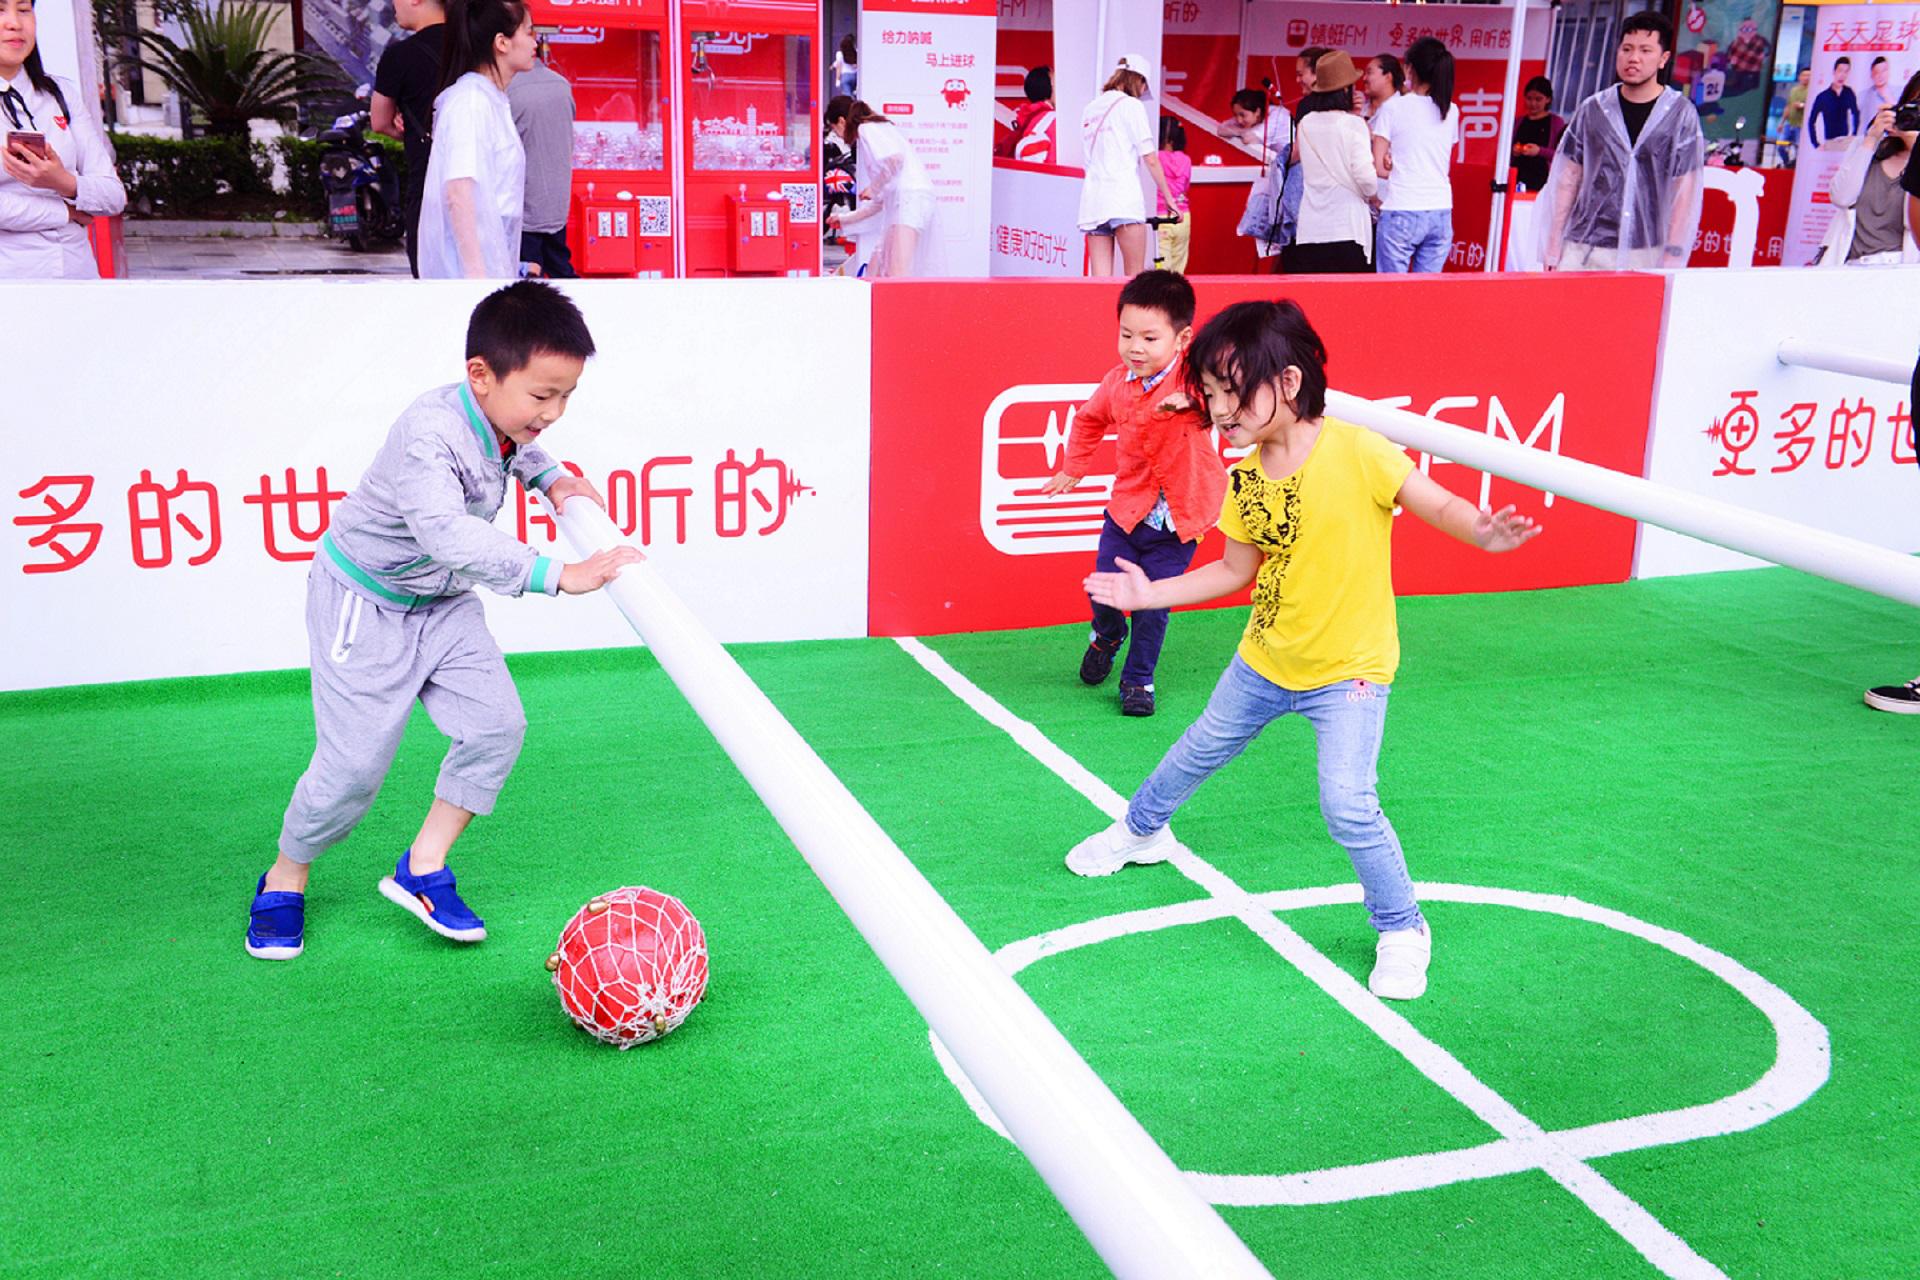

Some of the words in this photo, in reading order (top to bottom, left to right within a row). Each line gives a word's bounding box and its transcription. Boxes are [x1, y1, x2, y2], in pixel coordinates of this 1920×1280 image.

[925, 52, 975, 68] 马上进球
[1457, 88, 1503, 164] 声
[996, 224, 1067, 268] 健康好时光
